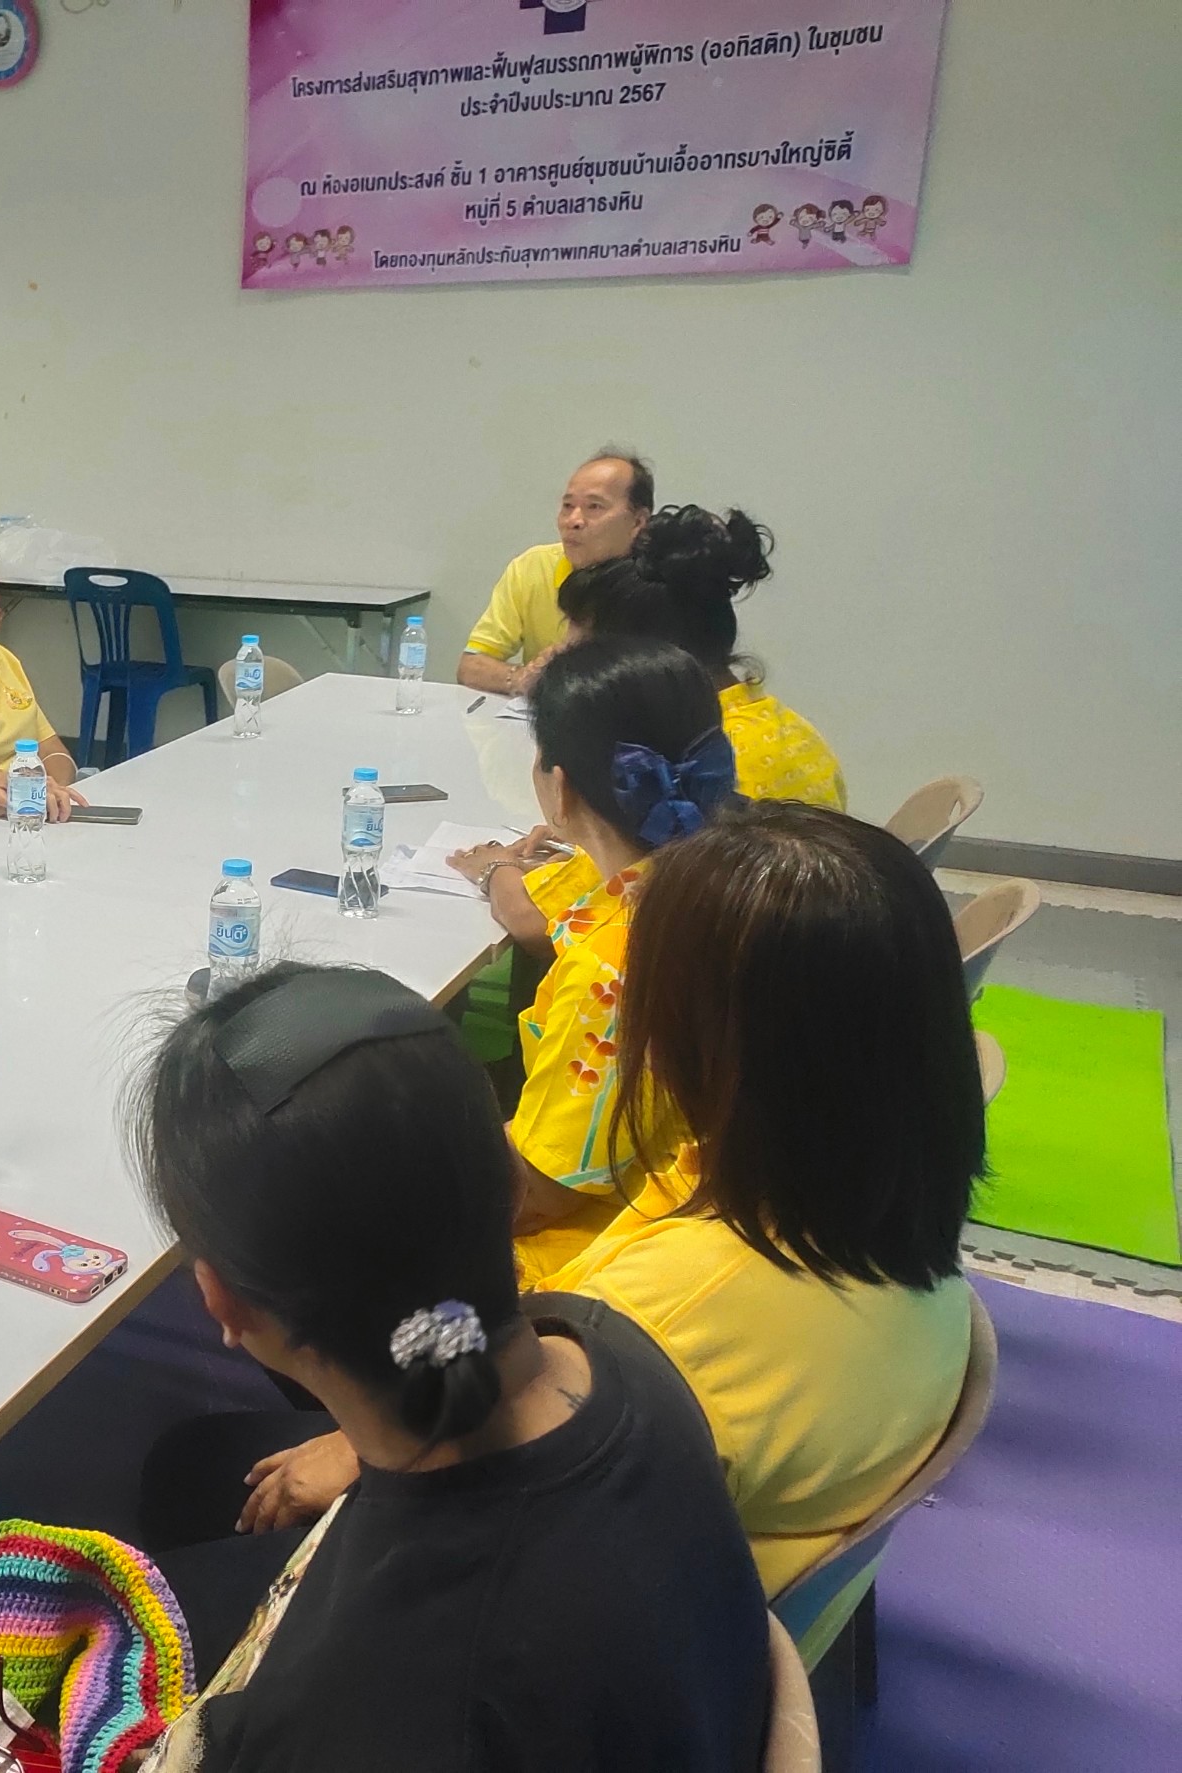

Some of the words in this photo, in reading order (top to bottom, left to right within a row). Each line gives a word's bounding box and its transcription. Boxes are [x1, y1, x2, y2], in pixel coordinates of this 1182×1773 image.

[292, 43, 694, 98] โครงการส่งเสริมสุขภาพและฟื้นฟูสมรรถภาพผู้พิการ
[700, 32, 801, 66] (ออทิสติก)
[807, 24, 884, 56] ในชุมชน
[461, 86, 614, 117] ประจำปีงบประมาณ
[619, 83, 667, 104] 2567
[300, 179, 317, 197] ณ
[322, 166, 447, 196] ห้องอเนกประสงค์
[451, 159, 472, 187] ชั้น
[478, 168, 486, 185] 1
[494, 131, 855, 188] อาคารศูนย์ชุมชนบ้านเอื้ออาทรบางใหญ่ซิตี้
[465, 193, 501, 226] หมู่ที่
[506, 200, 517, 217] 5
[522, 190, 644, 217] ตำบลเสาธงหิน
[374, 235, 741, 272] โดยกองทุนหลักประกันสุขภาพเทศบาลตำบลเสาธงหิน
